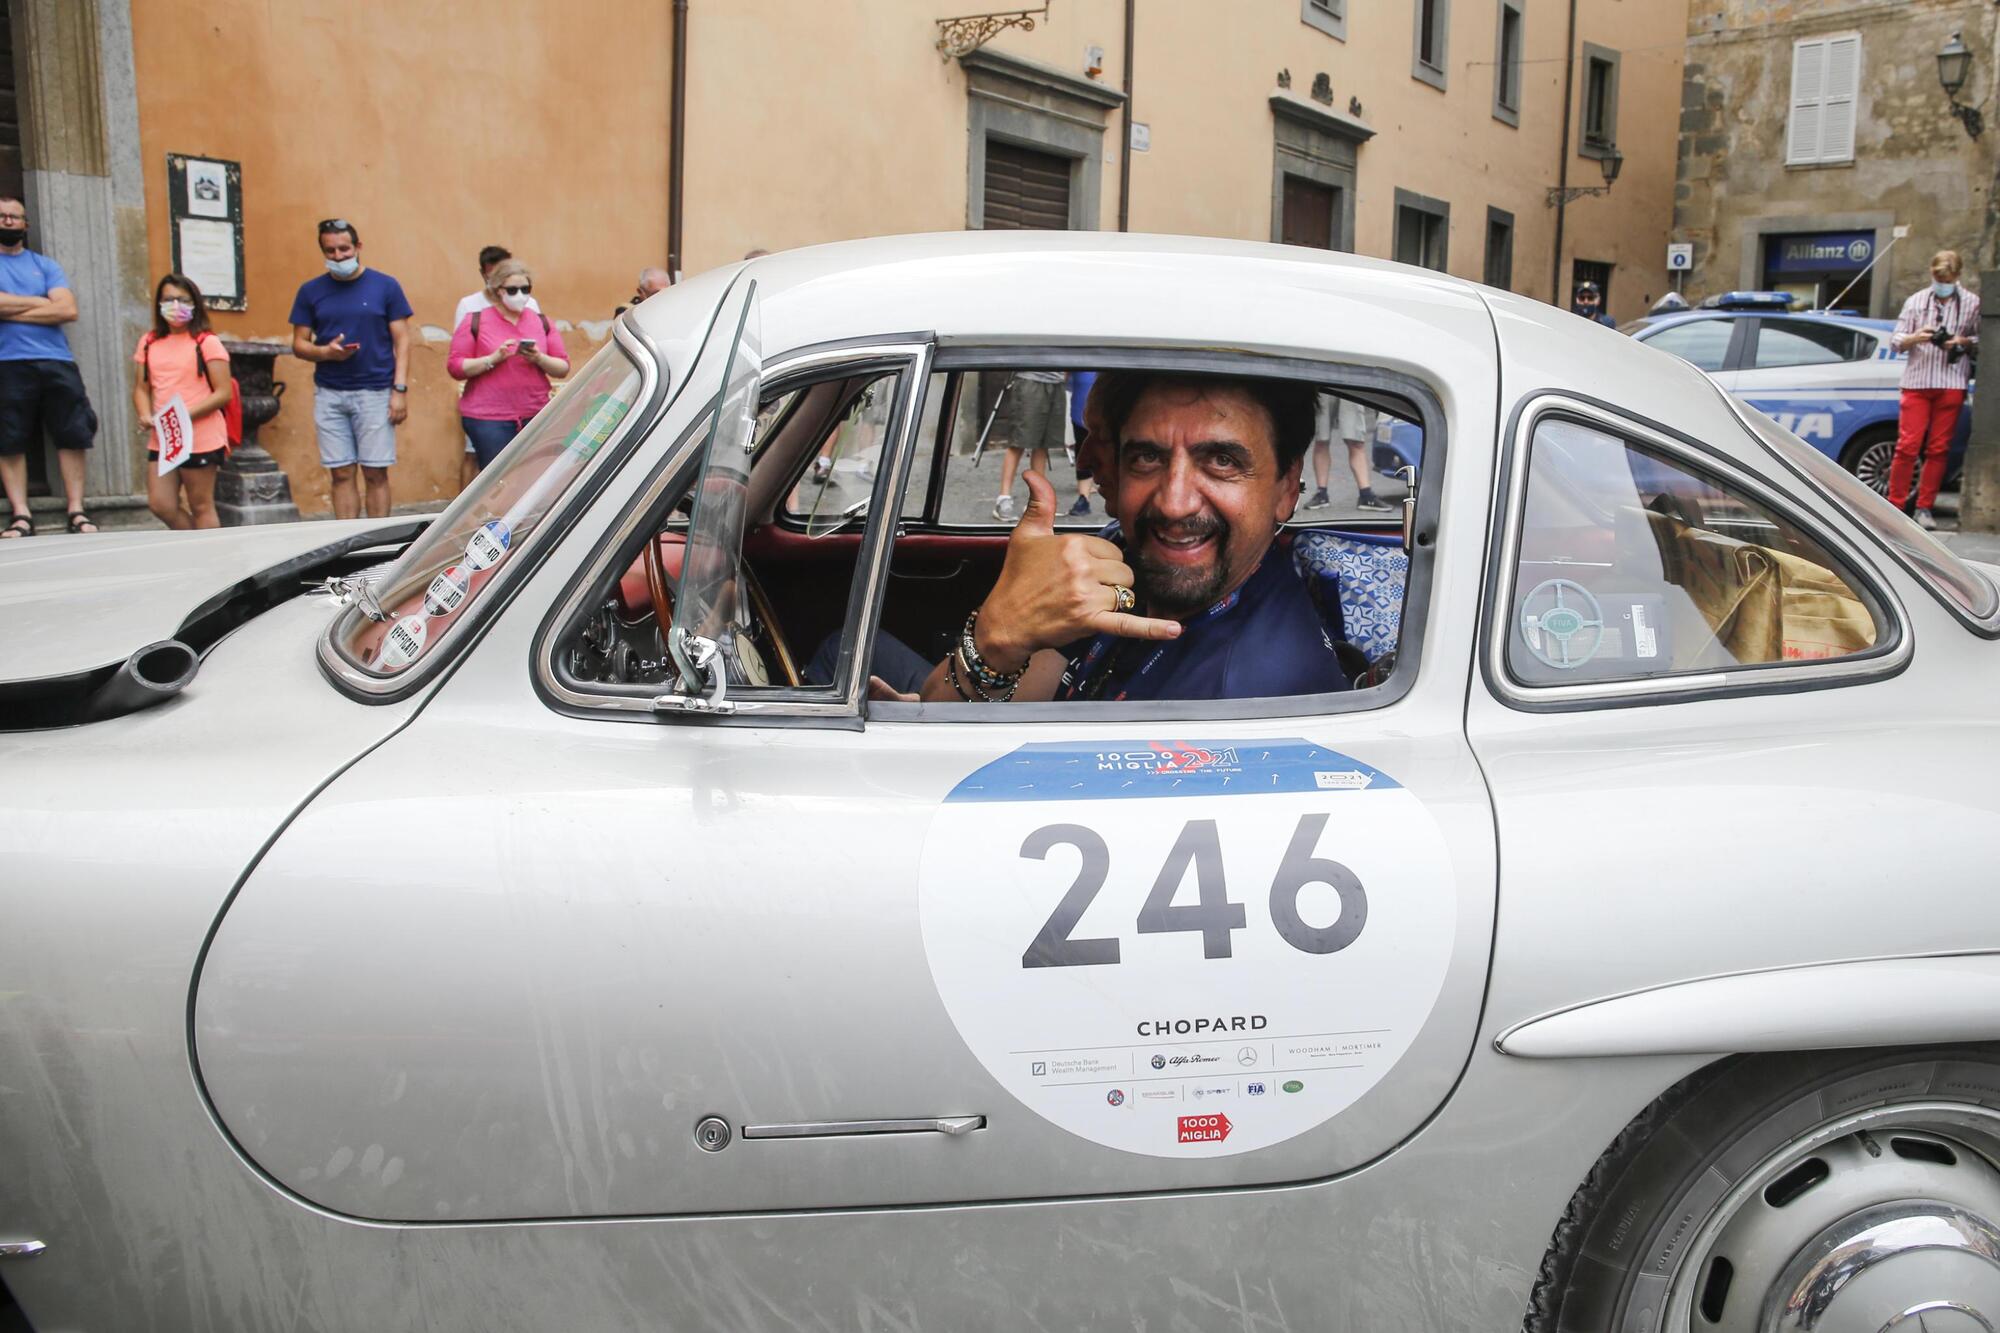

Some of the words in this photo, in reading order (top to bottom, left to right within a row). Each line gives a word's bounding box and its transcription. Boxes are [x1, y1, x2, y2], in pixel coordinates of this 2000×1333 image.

[1786, 243, 1845, 260] Allianz
[169, 411, 182, 447] 1000
[391, 624, 419, 657] VERIFICATO
[1181, 746, 1239, 768] 2021
[1097, 761, 1179, 771] MIGLIA
[1019, 813, 1368, 969] 246
[1136, 1014, 1268, 1037] CHOPARD
[1288, 1046, 1331, 1055] WOODHAM
[1341, 1042, 1382, 1051] MORTIMER
[1051, 1060, 1082, 1068] Deutsche
[1169, 1056, 1189, 1068] Alfa
[1190, 1053, 1220, 1064] Romeo
[1051, 1066, 1075, 1075] Wealth
[1076, 1064, 1118, 1073] Management
[1248, 1084, 1265, 1095] FIA
[1182, 1116, 1219, 1129] 1000
[1180, 1129, 1221, 1141] MIGLIA
